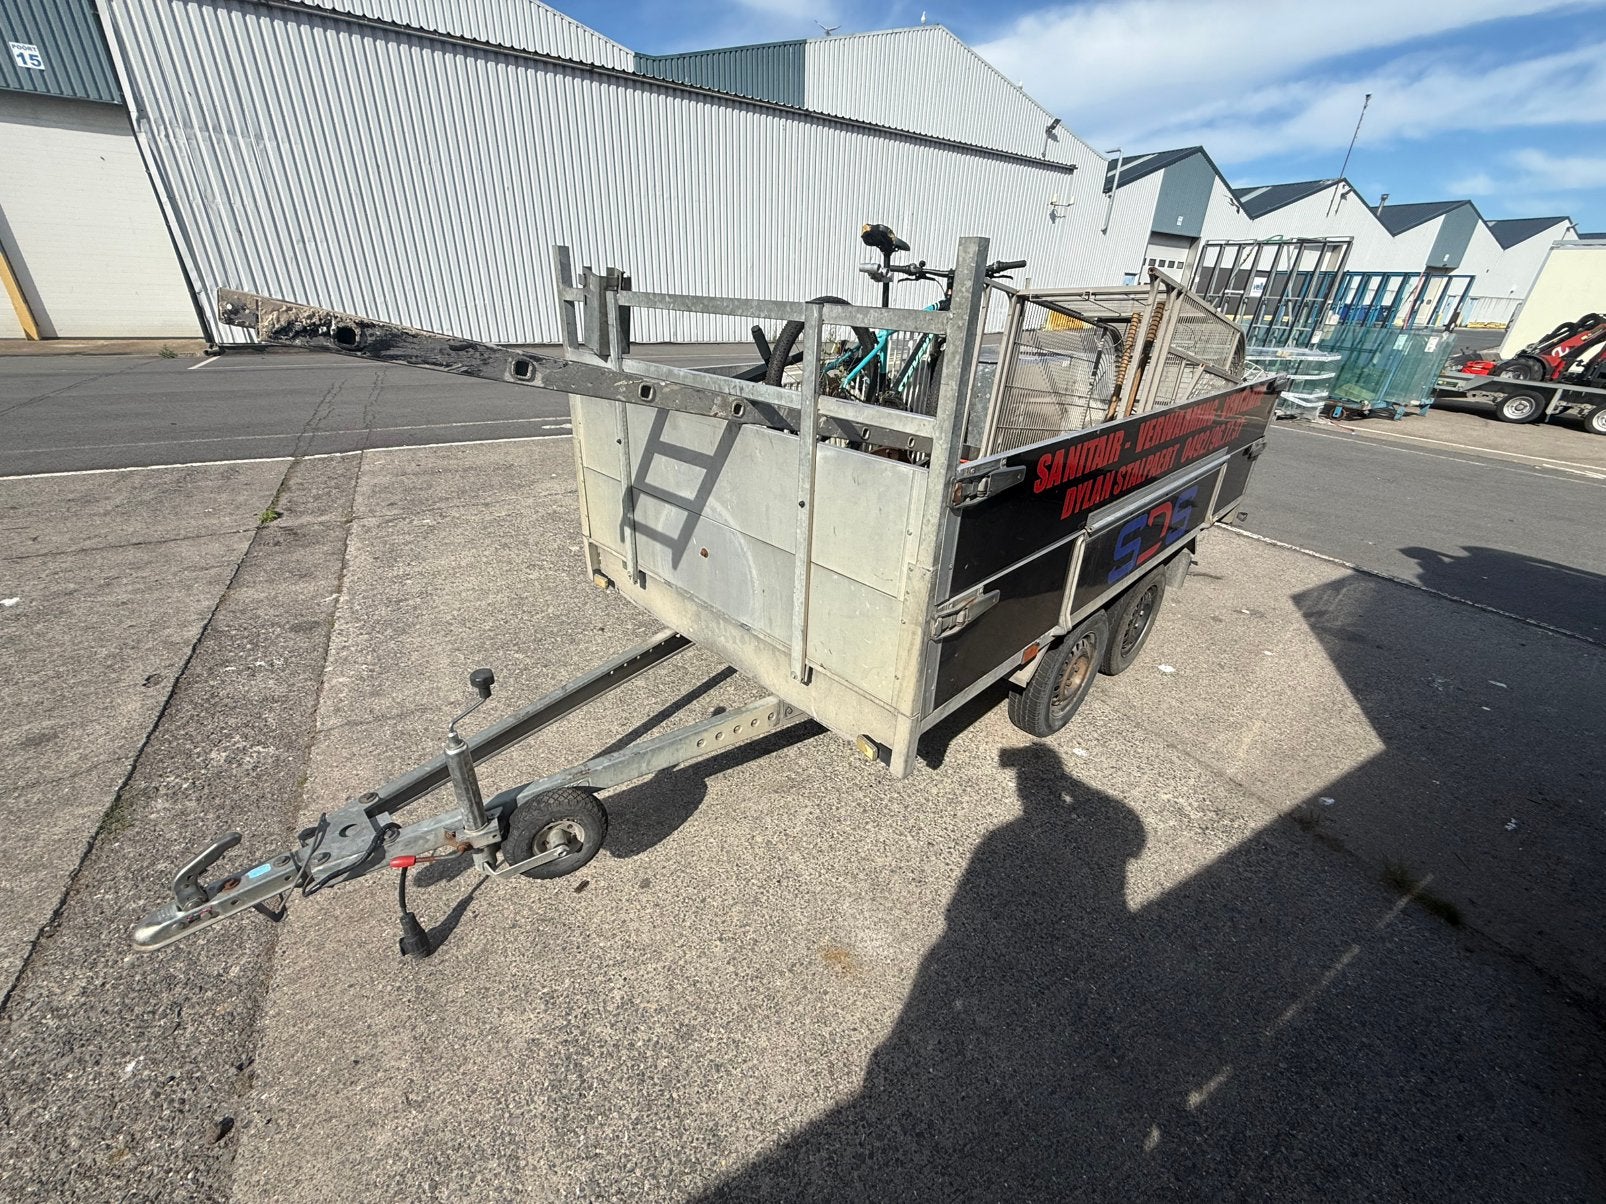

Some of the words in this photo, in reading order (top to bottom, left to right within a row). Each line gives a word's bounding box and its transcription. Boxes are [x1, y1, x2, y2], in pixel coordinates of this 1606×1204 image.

[16, 51, 42, 67] 15
[1033, 430, 1125, 494] SANITAIR
[1060, 469, 1116, 520] DYLAN
[1113, 443, 1180, 496] STALPAERT
